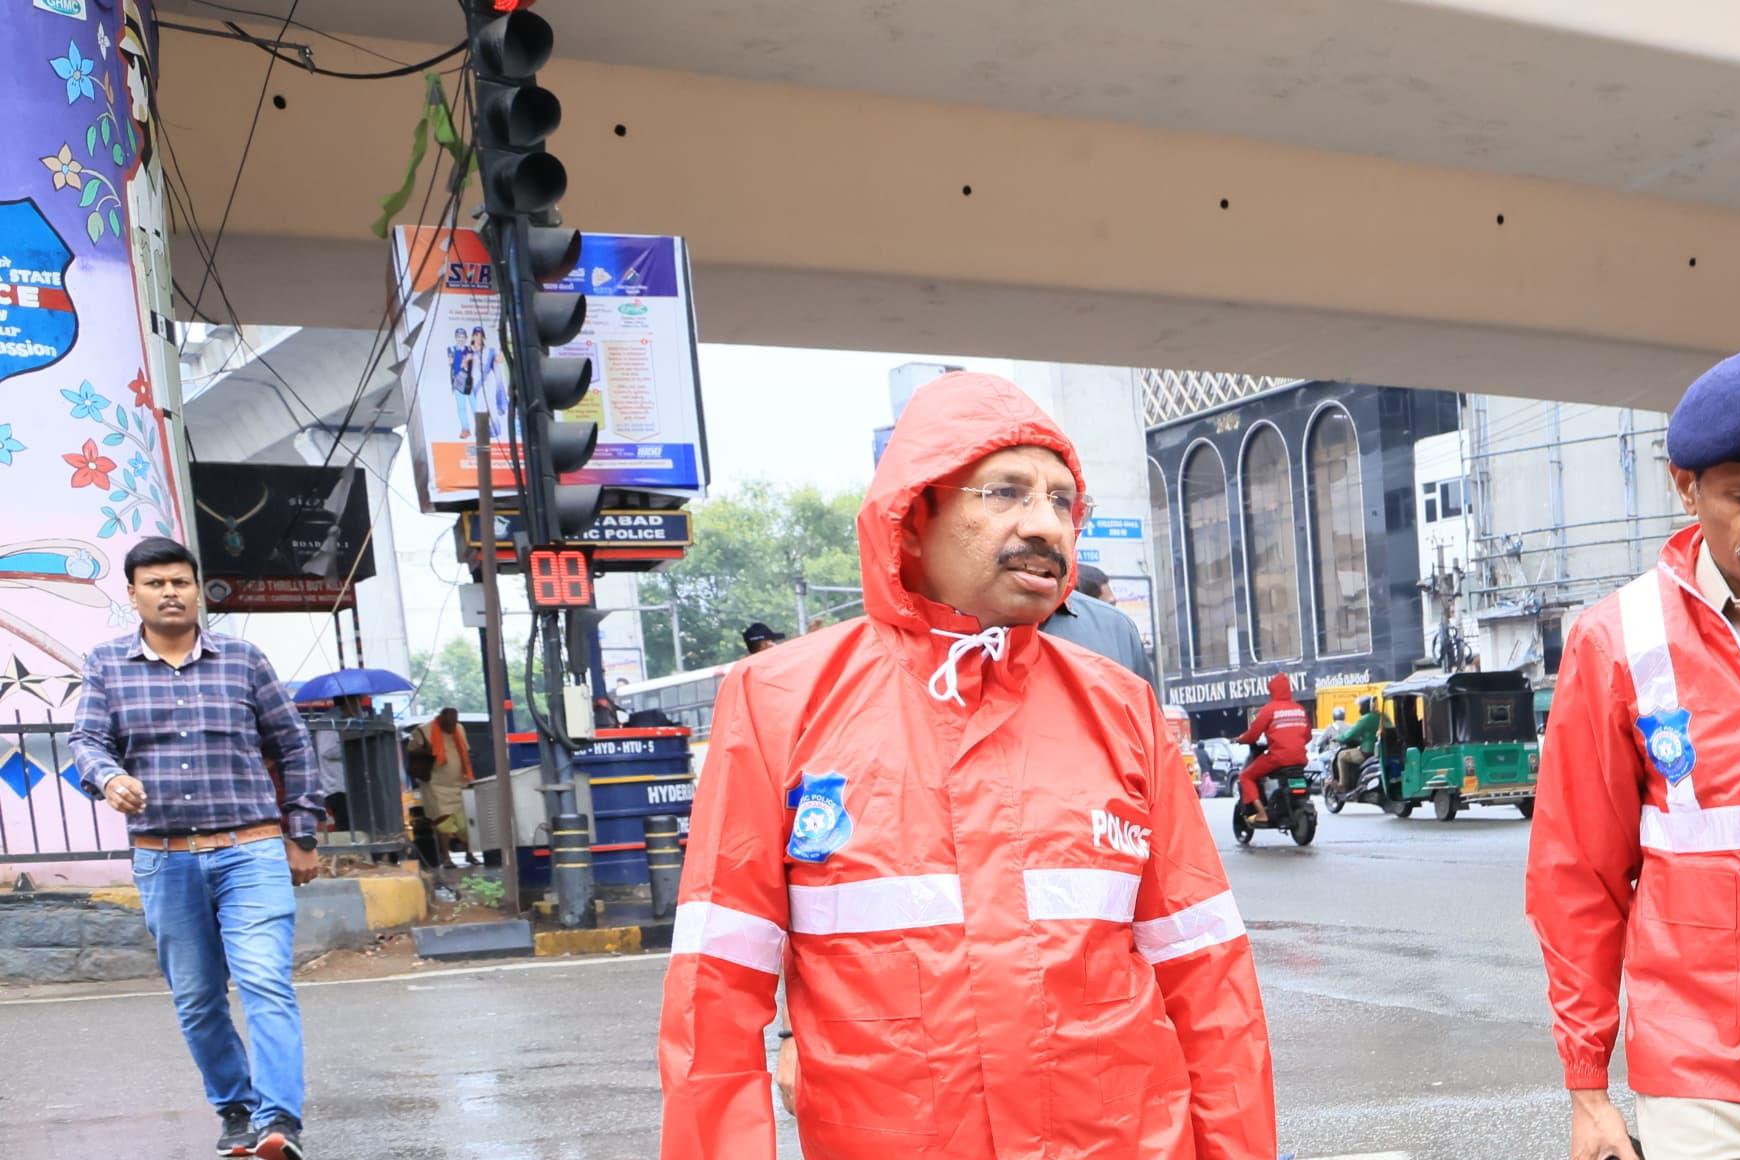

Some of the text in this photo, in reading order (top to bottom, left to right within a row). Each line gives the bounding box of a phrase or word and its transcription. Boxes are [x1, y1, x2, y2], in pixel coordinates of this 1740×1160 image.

[9, 268, 62, 286] STATE
[604, 528, 667, 540] POLICE
[1169, 681, 1226, 705] MERIDIAN
[1229, 672, 1307, 699] RESTAUNT
